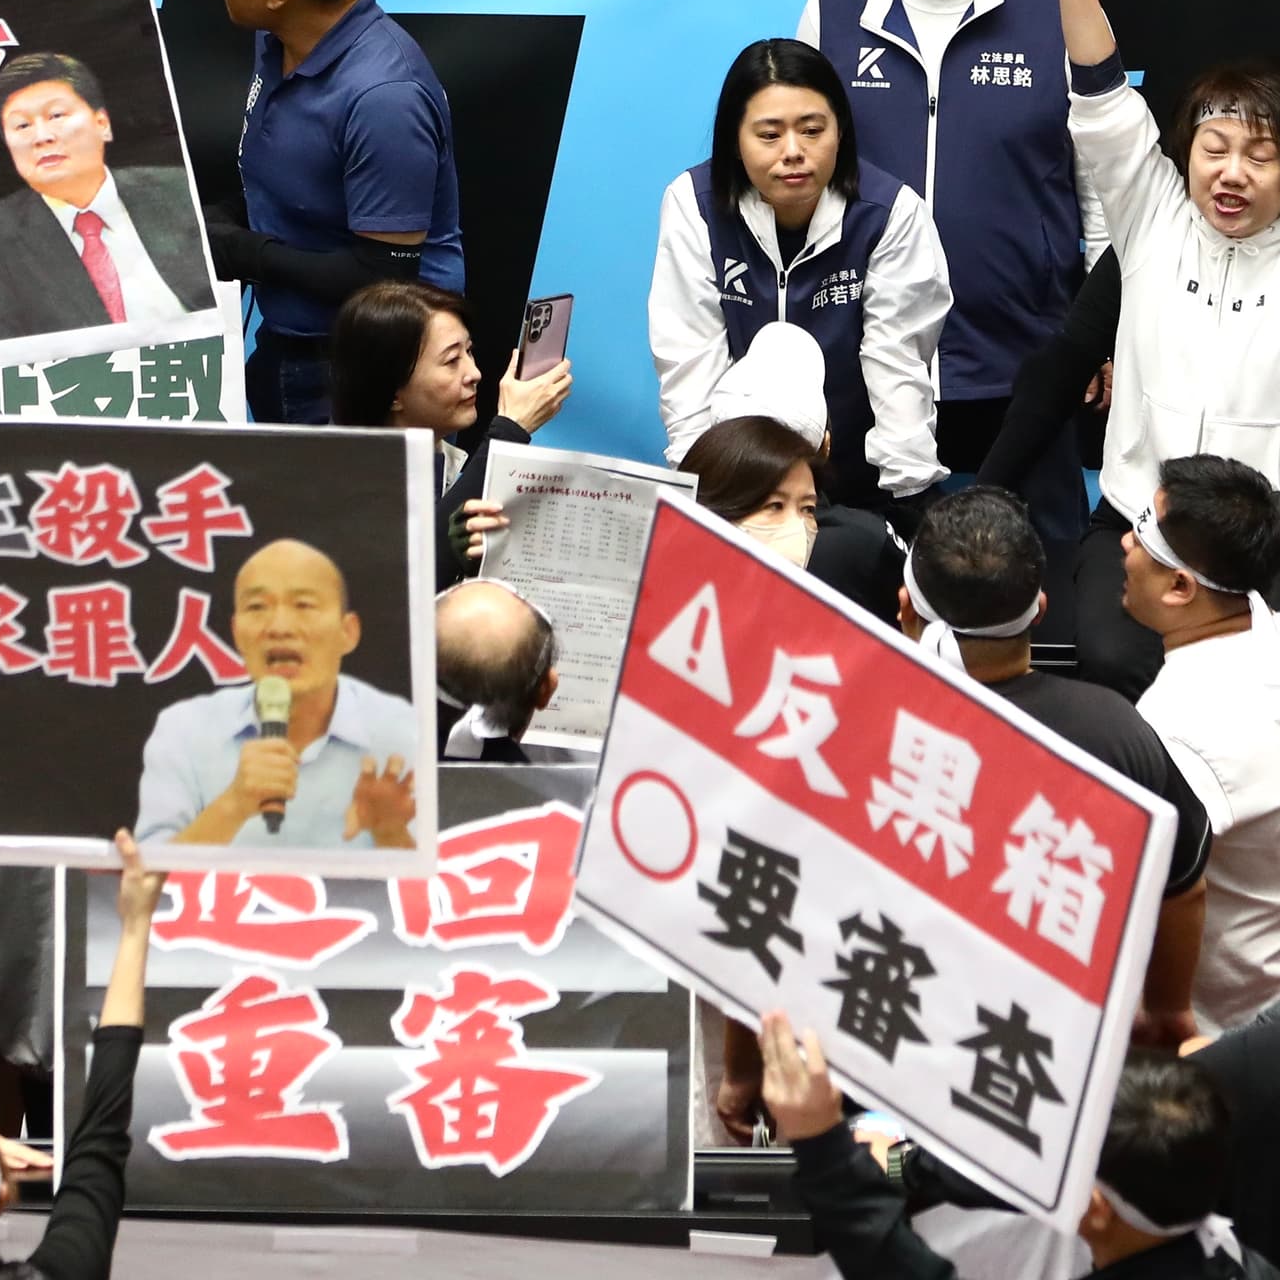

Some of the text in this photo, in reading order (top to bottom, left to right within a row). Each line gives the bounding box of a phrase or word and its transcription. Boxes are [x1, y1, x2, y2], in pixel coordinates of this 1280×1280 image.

[970, 66, 1032, 87] 林思銘
[980, 53, 1025, 64] 立法委員
[736, 646, 1116, 968] 反黑箱
[147, 963, 604, 1178] 重審
[696, 826, 1067, 1160] 要審查
